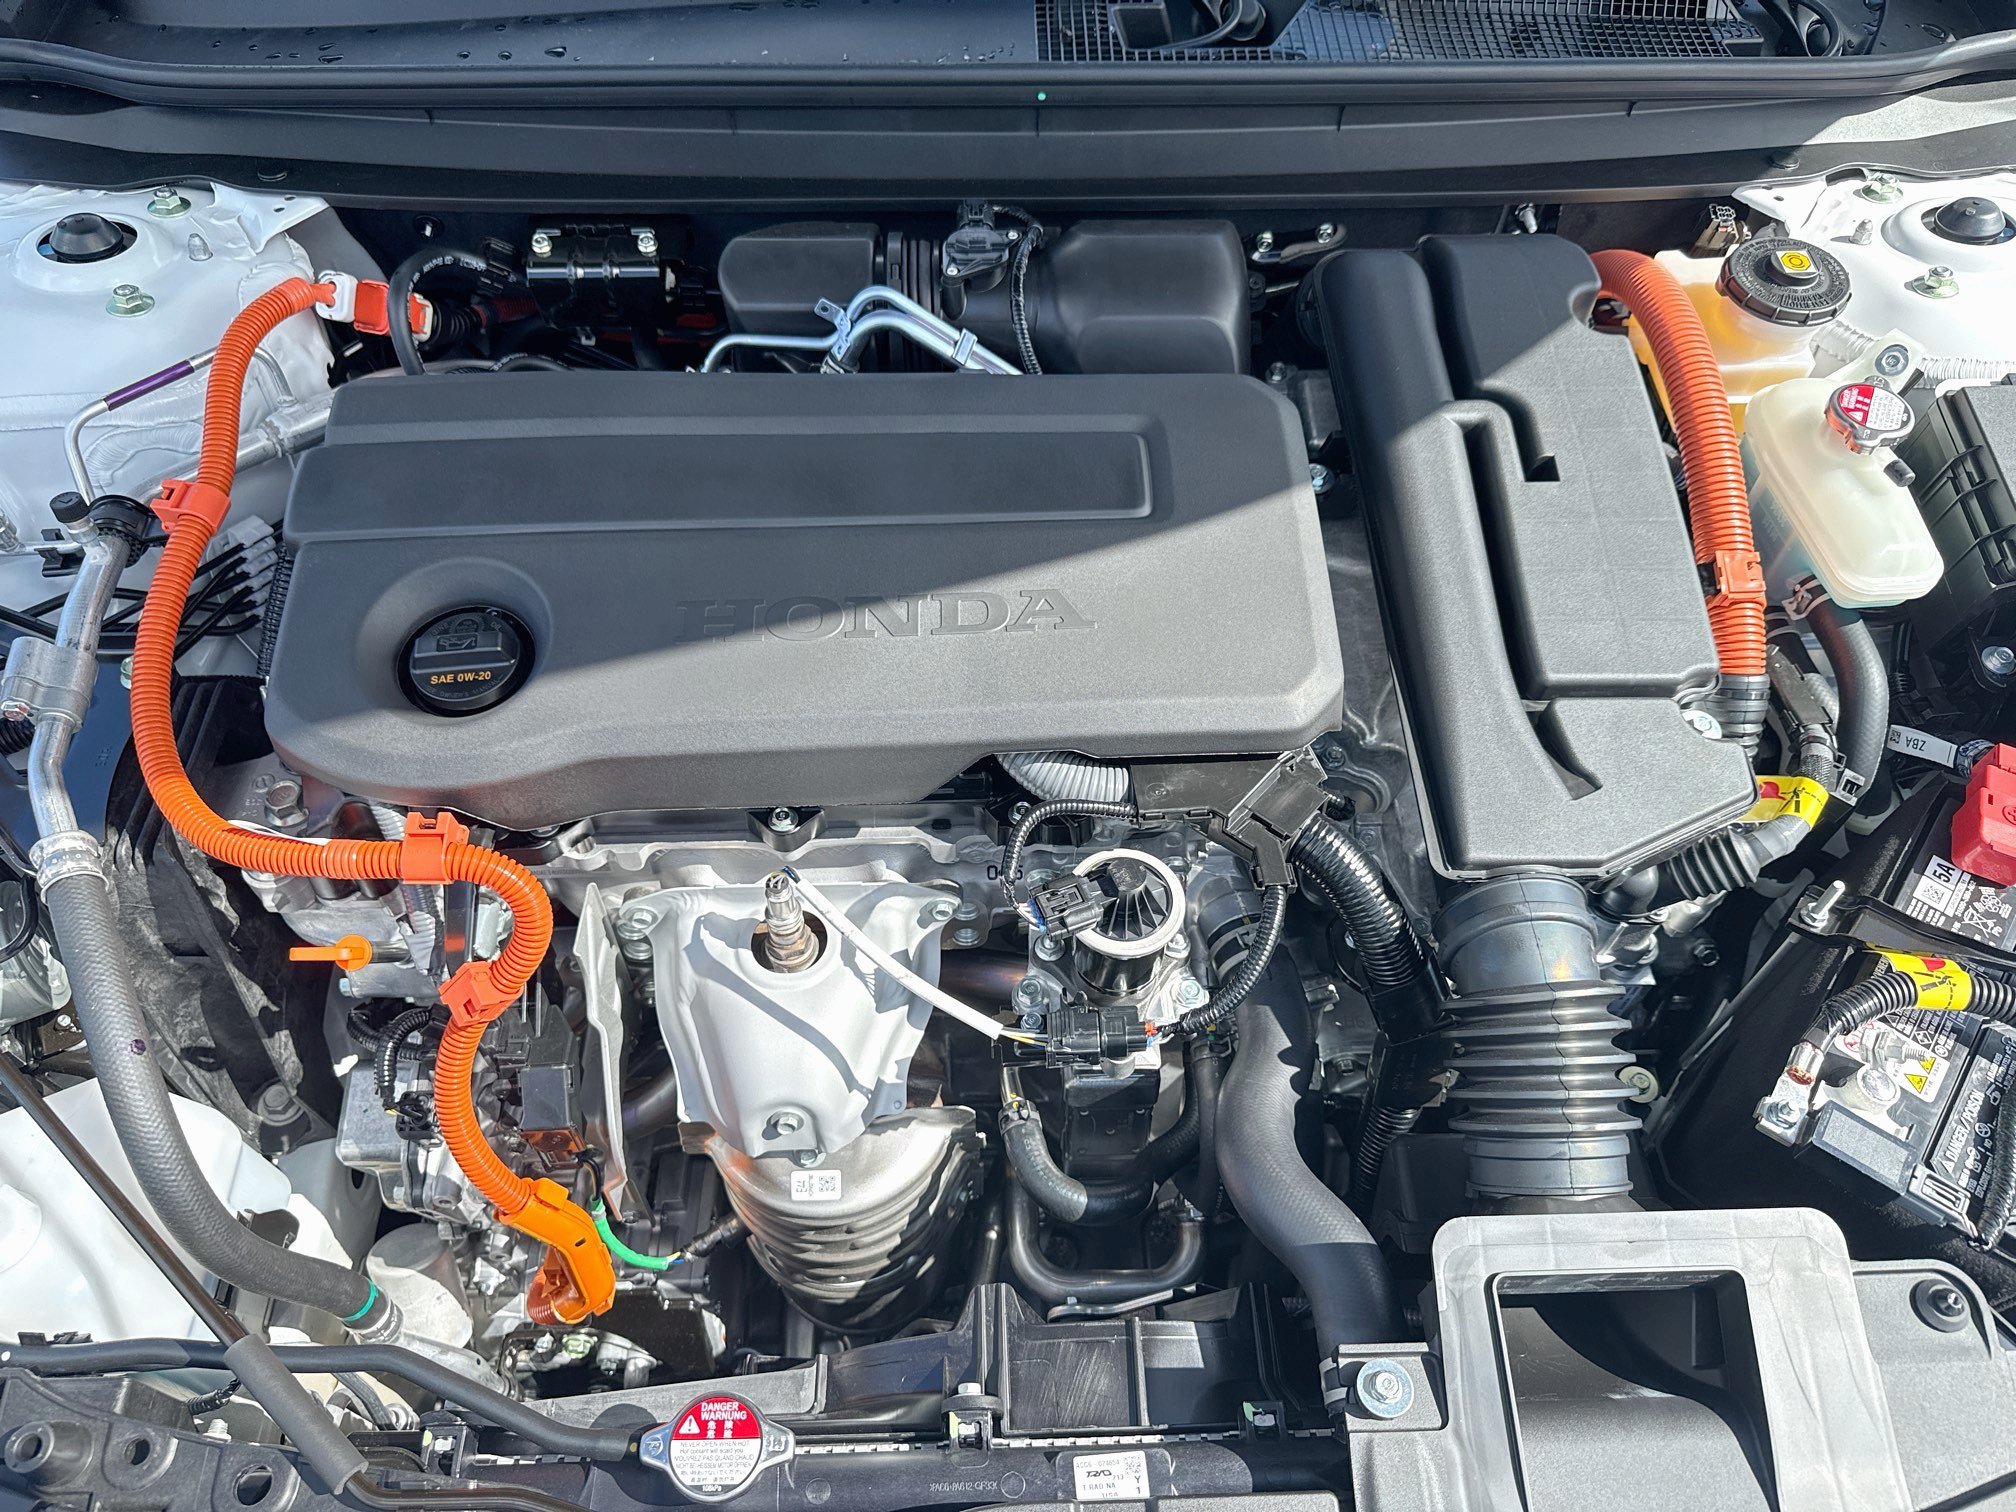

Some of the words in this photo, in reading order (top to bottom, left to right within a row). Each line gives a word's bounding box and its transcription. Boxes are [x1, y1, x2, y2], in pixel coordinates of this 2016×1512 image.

[675, 588, 1098, 643] HONDA
[431, 674, 454, 684] SAE
[458, 671, 491, 681] 0W-20
[1906, 736, 1927, 751] ZBA
[1932, 860, 1955, 883] 5A
[1992, 925, 2003, 937] Pb
[701, 1402, 738, 1411] DANGER
[701, 1411, 747, 1420] WARNUNG
